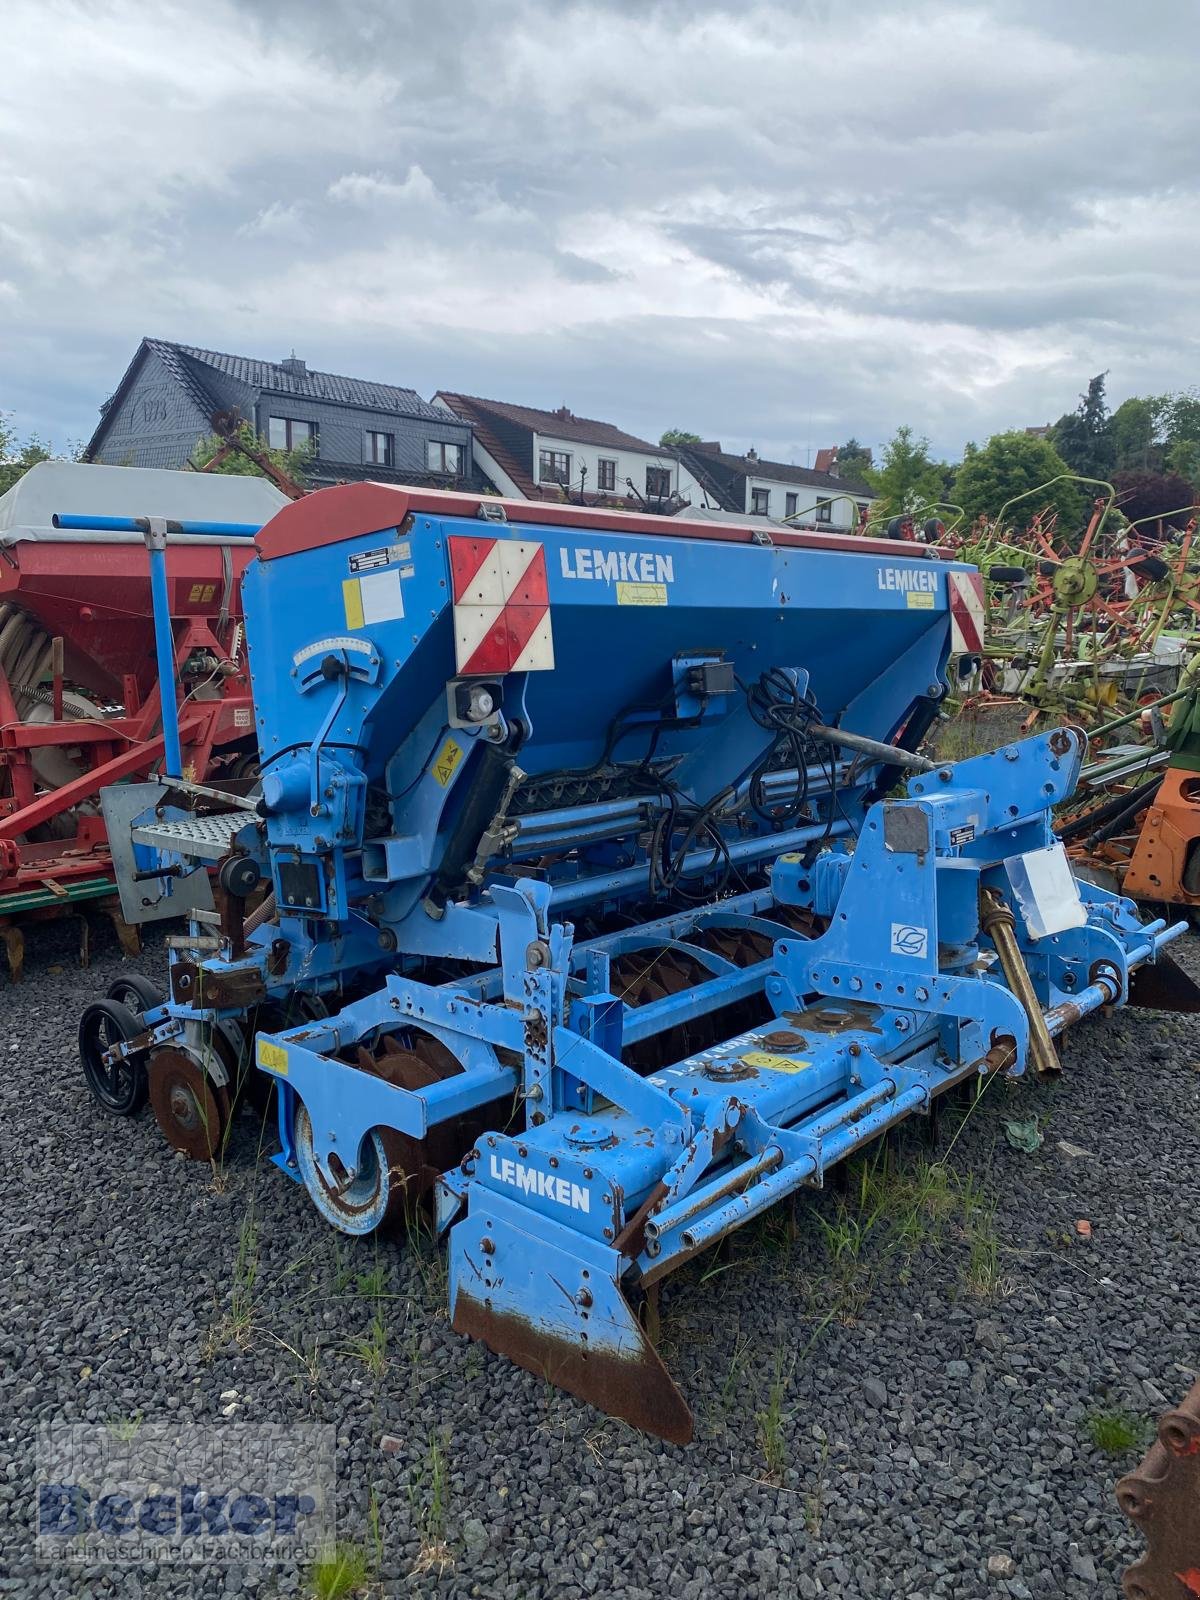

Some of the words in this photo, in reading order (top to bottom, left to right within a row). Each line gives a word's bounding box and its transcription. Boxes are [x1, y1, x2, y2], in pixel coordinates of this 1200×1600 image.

[559, 547, 675, 587] LEMKEN
[878, 568, 939, 596] LEMKEN
[490, 1154, 590, 1214] LEMKEN
